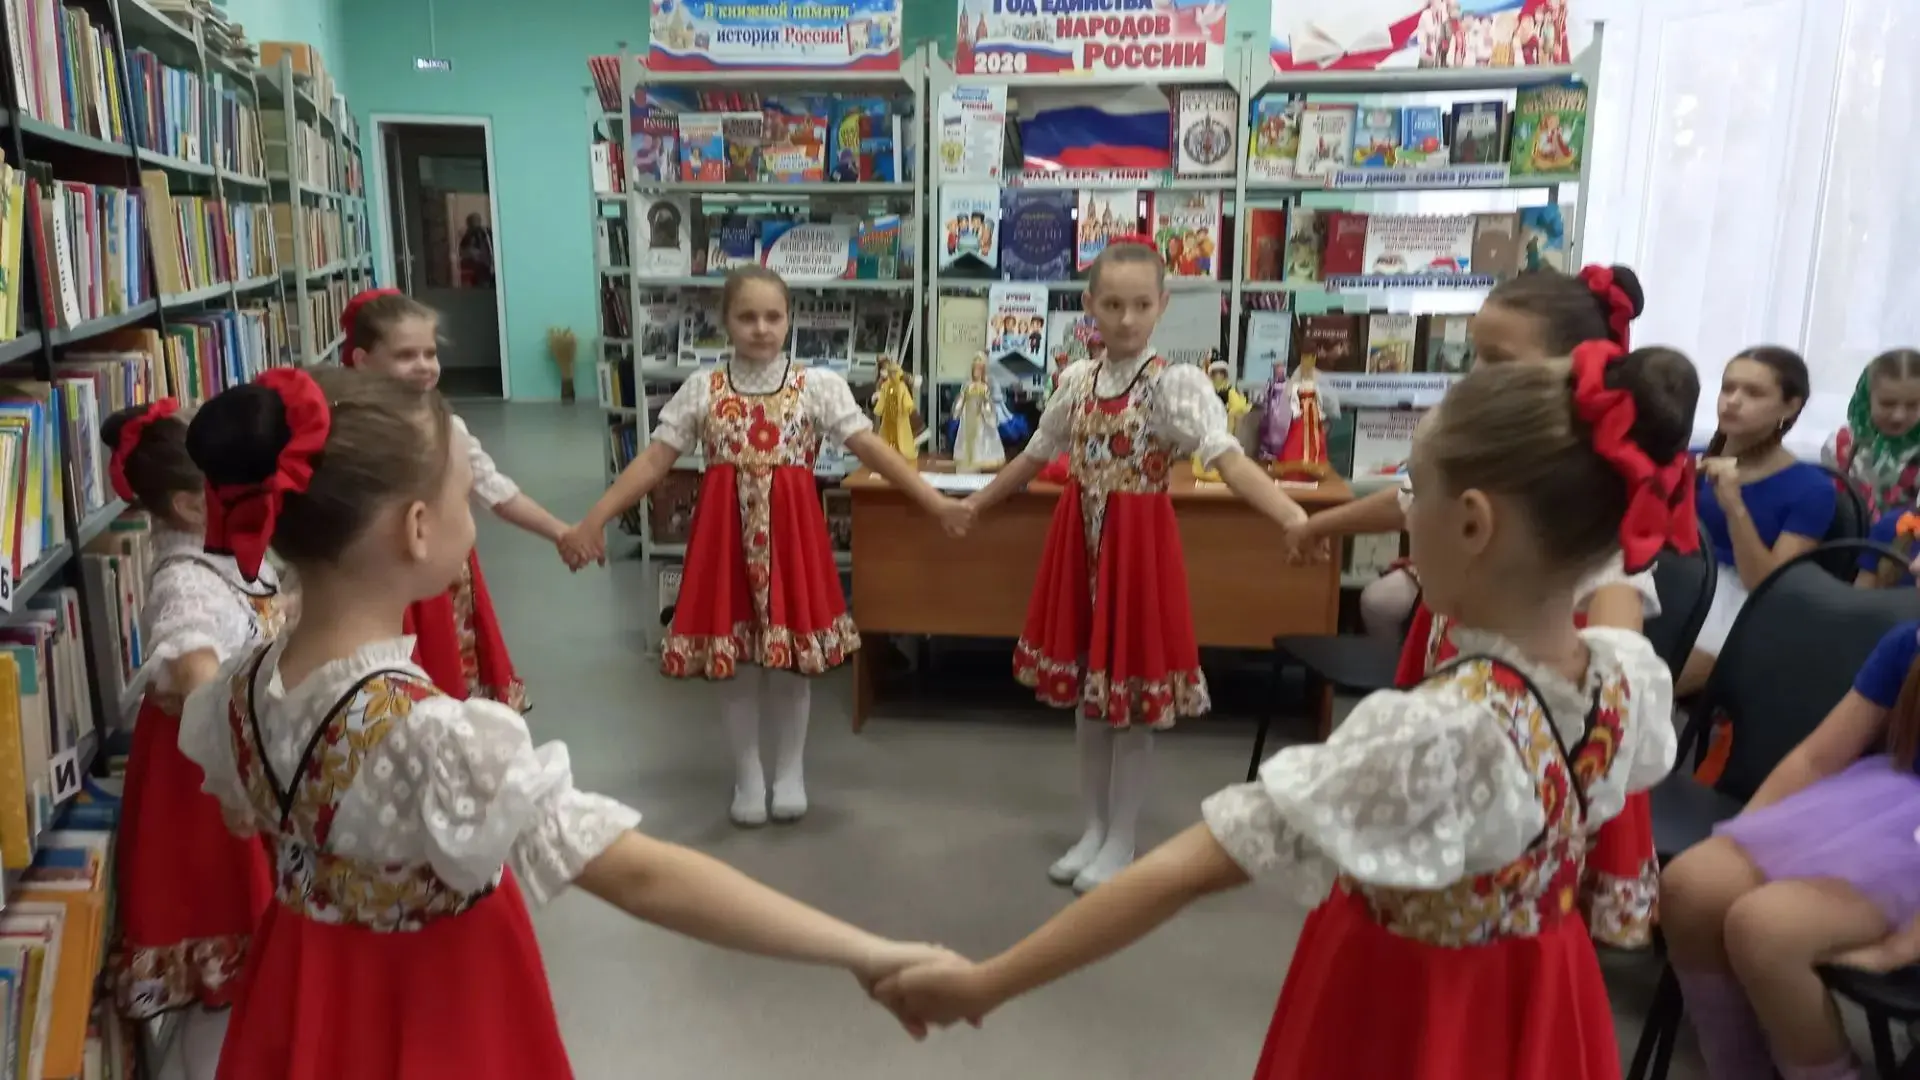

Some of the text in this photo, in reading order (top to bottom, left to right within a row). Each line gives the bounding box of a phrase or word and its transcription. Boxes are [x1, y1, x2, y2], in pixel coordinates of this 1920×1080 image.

[718, 3, 787, 18] книжной
[793, 5, 849, 18] памяти
[993, 0, 1153, 16] ГОД ЕДИНСТВА
[717, 26, 844, 46] история России!
[1056, 16, 1171, 39] НАРОДОВ
[1083, 42, 1207, 69] РОССИИ
[1109, 168, 1149, 180] ГИМН
[1335, 171, 1363, 187] Диво
[1365, 172, 1406, 188] дивное
[1415, 171, 1455, 183] сказка
[1457, 171, 1505, 187] русская
[1332, 275, 1495, 289] Сказки разных народов
[55, 757, 76, 796] И
